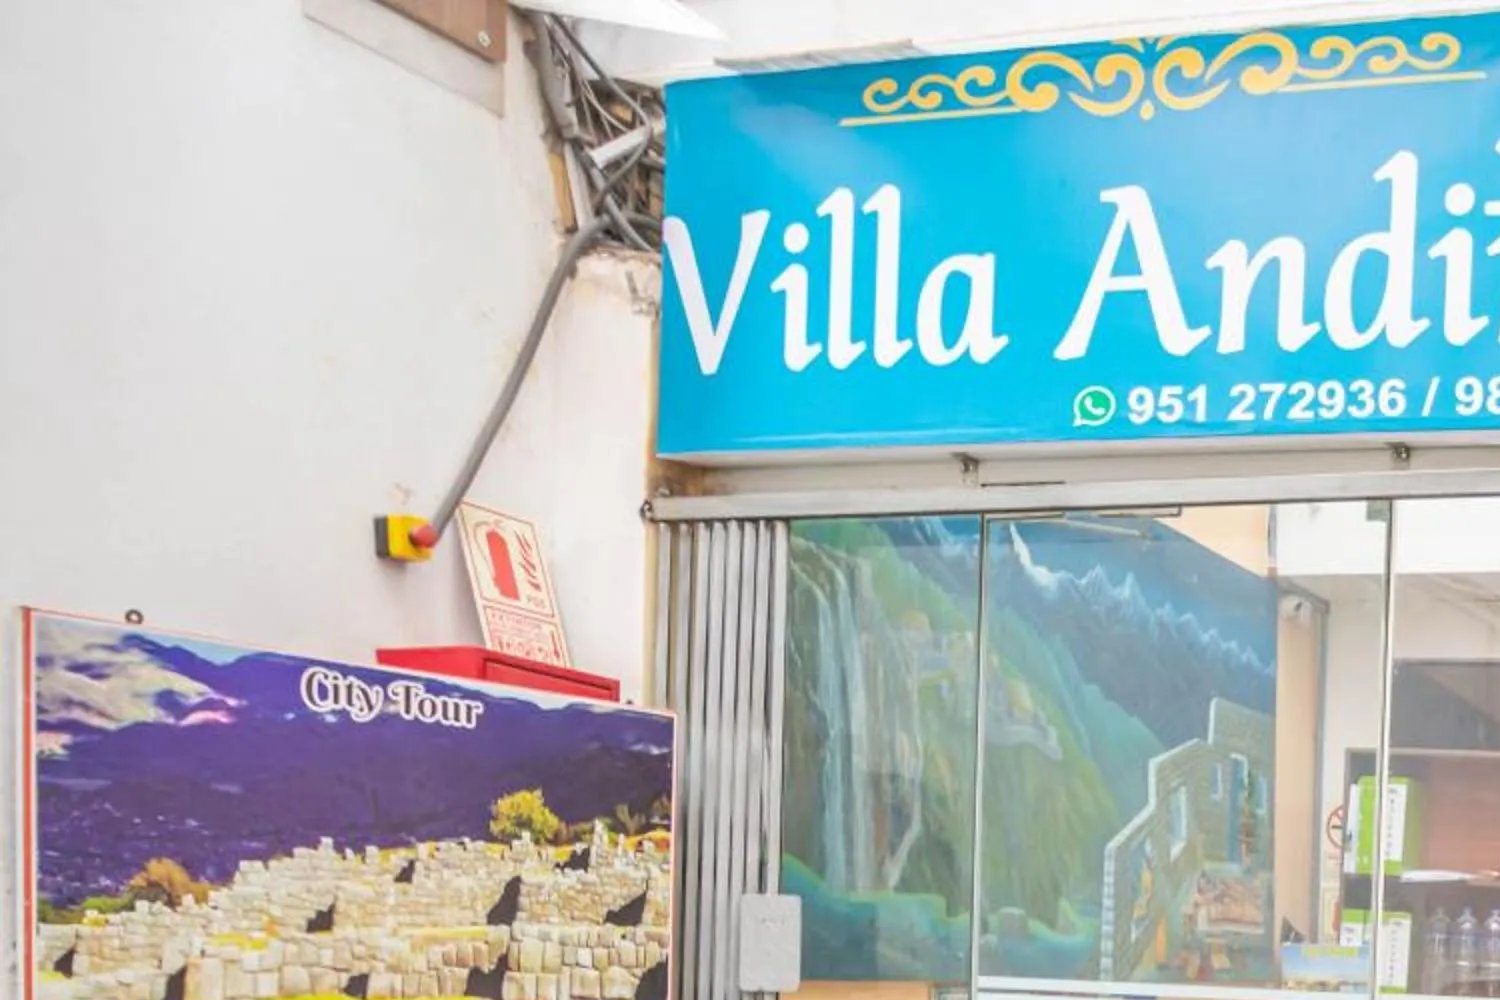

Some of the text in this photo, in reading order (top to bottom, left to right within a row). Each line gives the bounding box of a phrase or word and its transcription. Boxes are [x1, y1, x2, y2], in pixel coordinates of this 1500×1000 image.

[662, 184, 1009, 377] Villa
[1127, 384, 1208, 425] 951
[1227, 378, 1408, 422] 272936
[1421, 376, 1441, 417] /
[303, 669, 483, 727] City Tour
